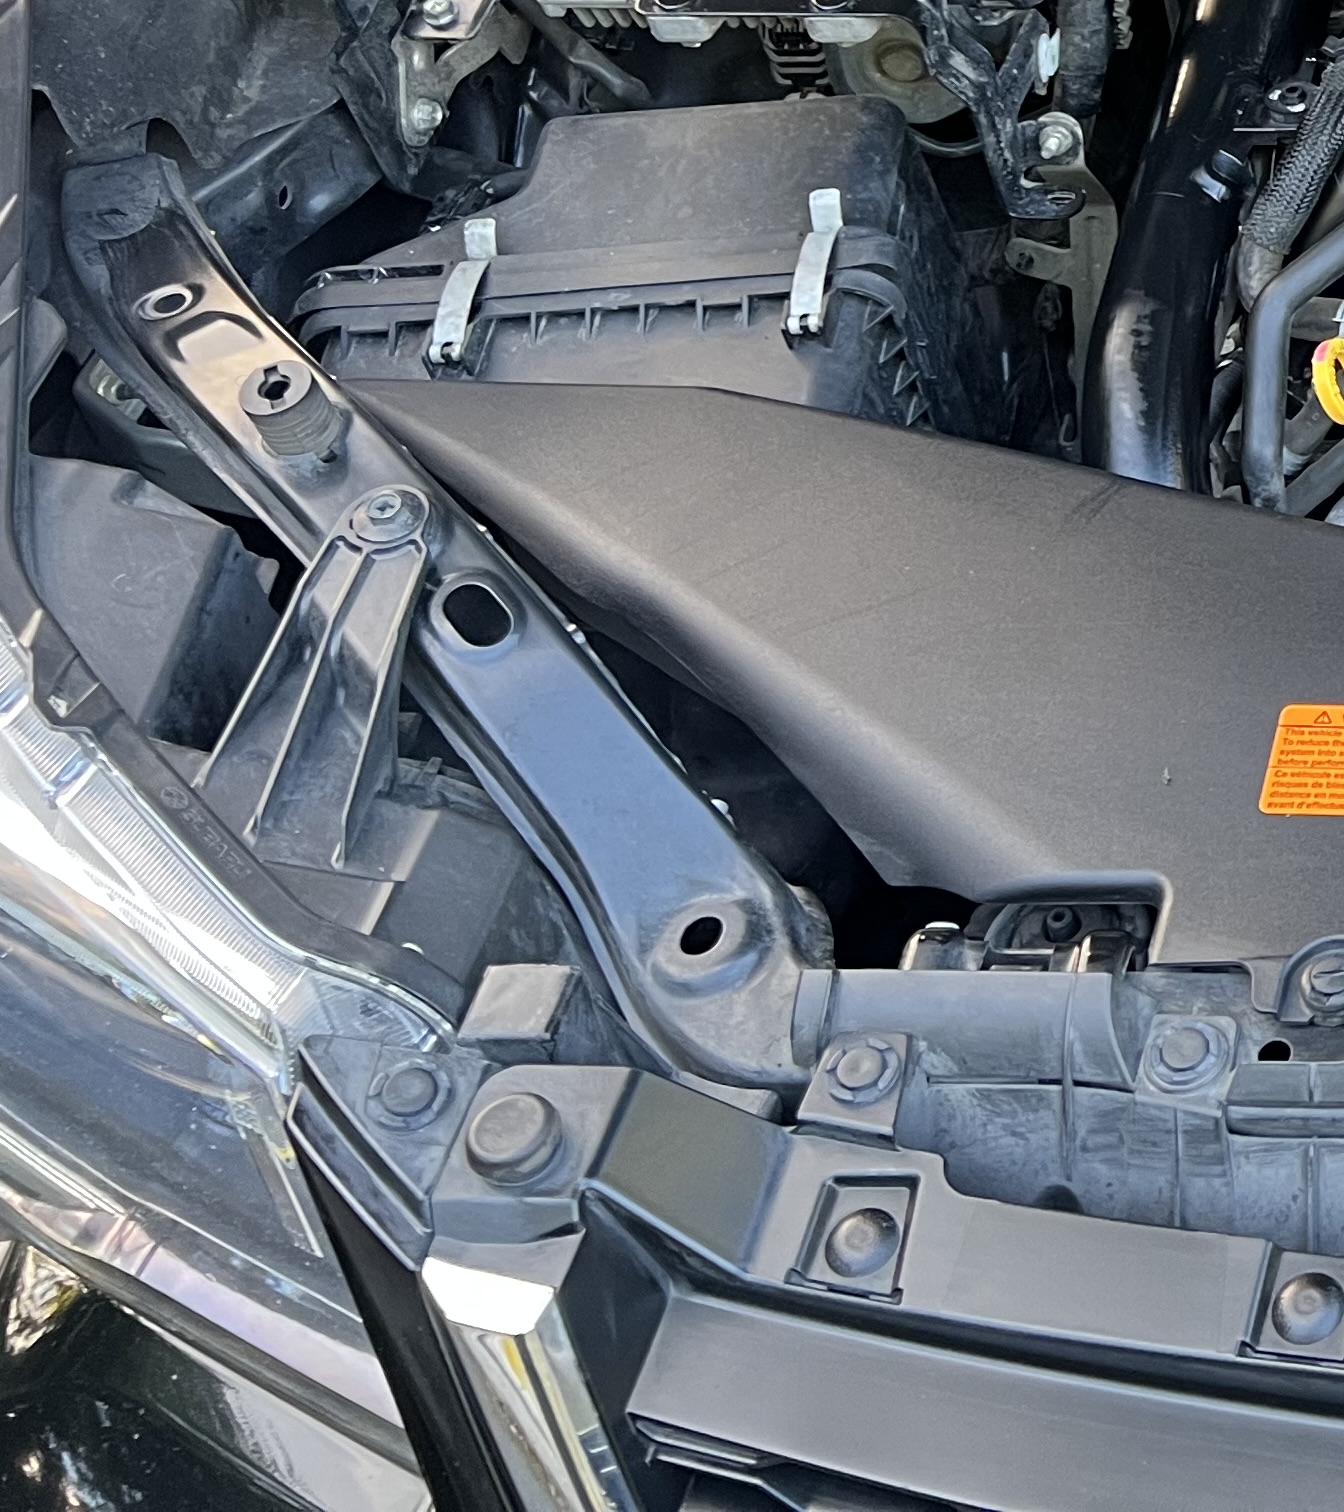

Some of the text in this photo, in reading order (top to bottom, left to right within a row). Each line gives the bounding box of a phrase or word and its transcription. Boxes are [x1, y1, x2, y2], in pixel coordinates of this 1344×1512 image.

[1308, 729, 1342, 737] vehicle
[1283, 737, 1294, 746] To
[1280, 749, 1315, 757] system
[1277, 758, 1309, 766] before
[1274, 770, 1288, 778] Ce
[1271, 781, 1308, 789] risques
[1311, 781, 1324, 789] de
[1269, 790, 1311, 799] distance
[1267, 801, 1295, 809] avant
